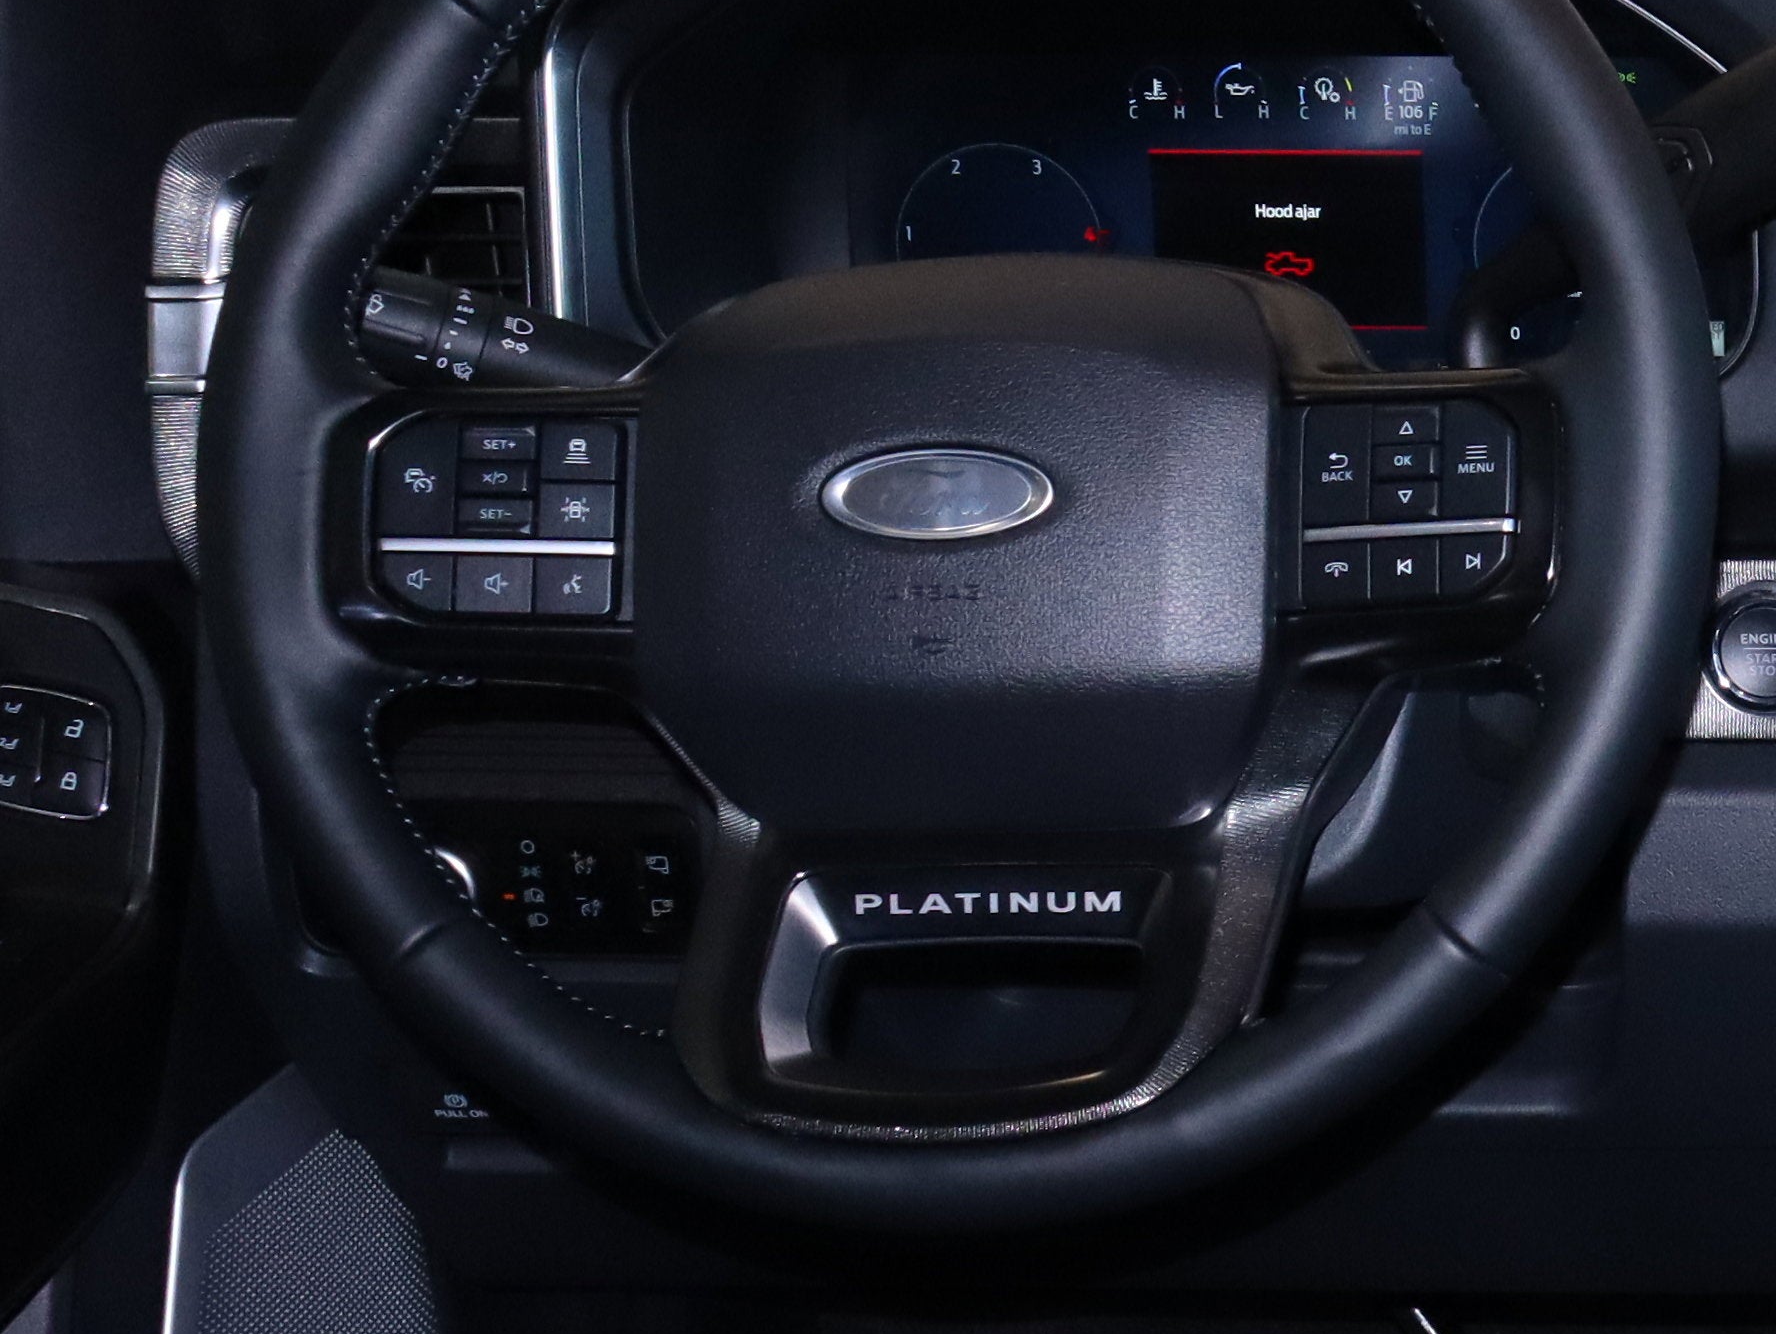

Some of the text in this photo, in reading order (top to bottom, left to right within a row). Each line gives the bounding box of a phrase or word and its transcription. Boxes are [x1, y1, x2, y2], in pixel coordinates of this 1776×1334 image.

[1129, 105, 1139, 120] C
[1173, 105, 1186, 120] H
[1214, 104, 1224, 119] L
[1258, 105, 1270, 120] H
[1299, 106, 1310, 120] C
[1345, 106, 1357, 121] H
[1399, 104, 1424, 119] 106
[1394, 124, 1432, 136] mi to E
[951, 159, 961, 175] 2
[1032, 159, 1042, 175] 3
[1255, 204, 1322, 221] Hood ajar
[1510, 326, 1520, 340] 0
[1393, 455, 1413, 466] OK
[1457, 462, 1495, 474] MENU
[1321, 470, 1354, 482] BACK
[854, 890, 1122, 915] PLATINUM
